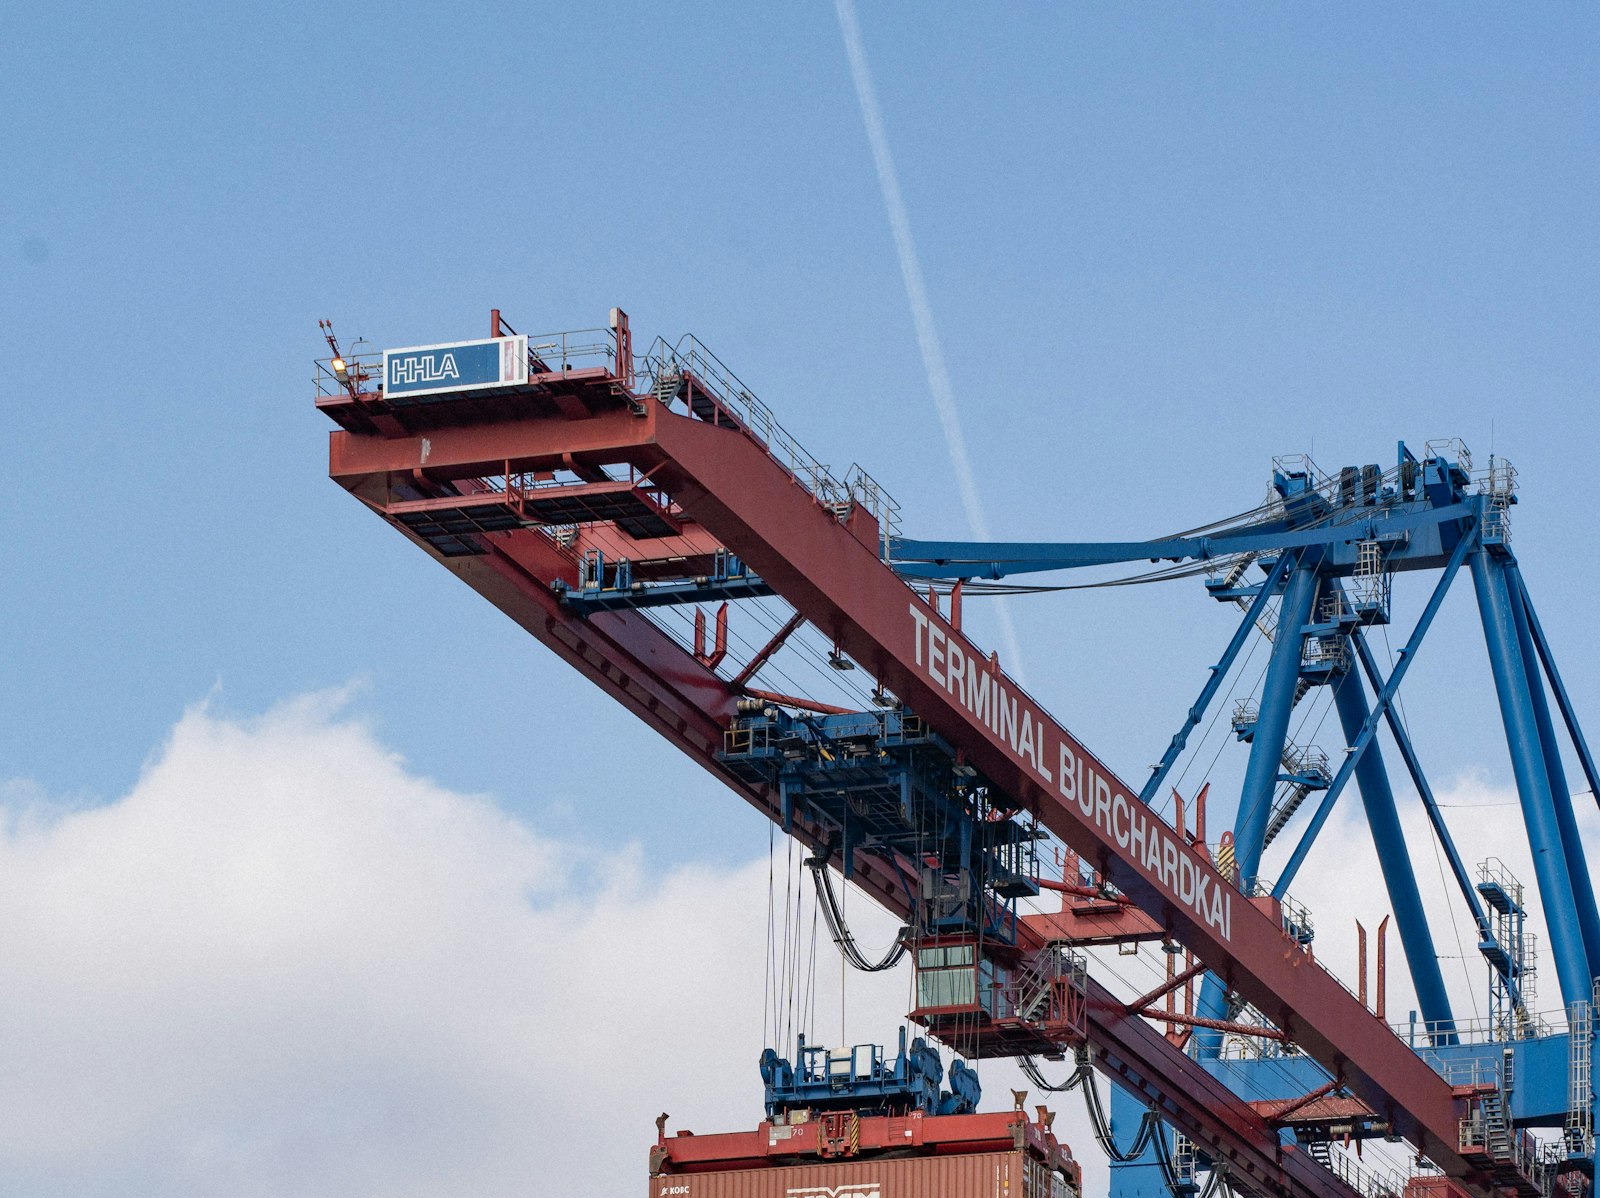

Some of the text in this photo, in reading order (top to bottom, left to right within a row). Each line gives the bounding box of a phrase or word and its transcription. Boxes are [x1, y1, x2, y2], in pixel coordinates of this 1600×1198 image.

[391, 353, 460, 385] HHLA
[909, 602, 1233, 943] TERMINAL BURCHARDKAI
[669, 1185, 690, 1195] KOBC
